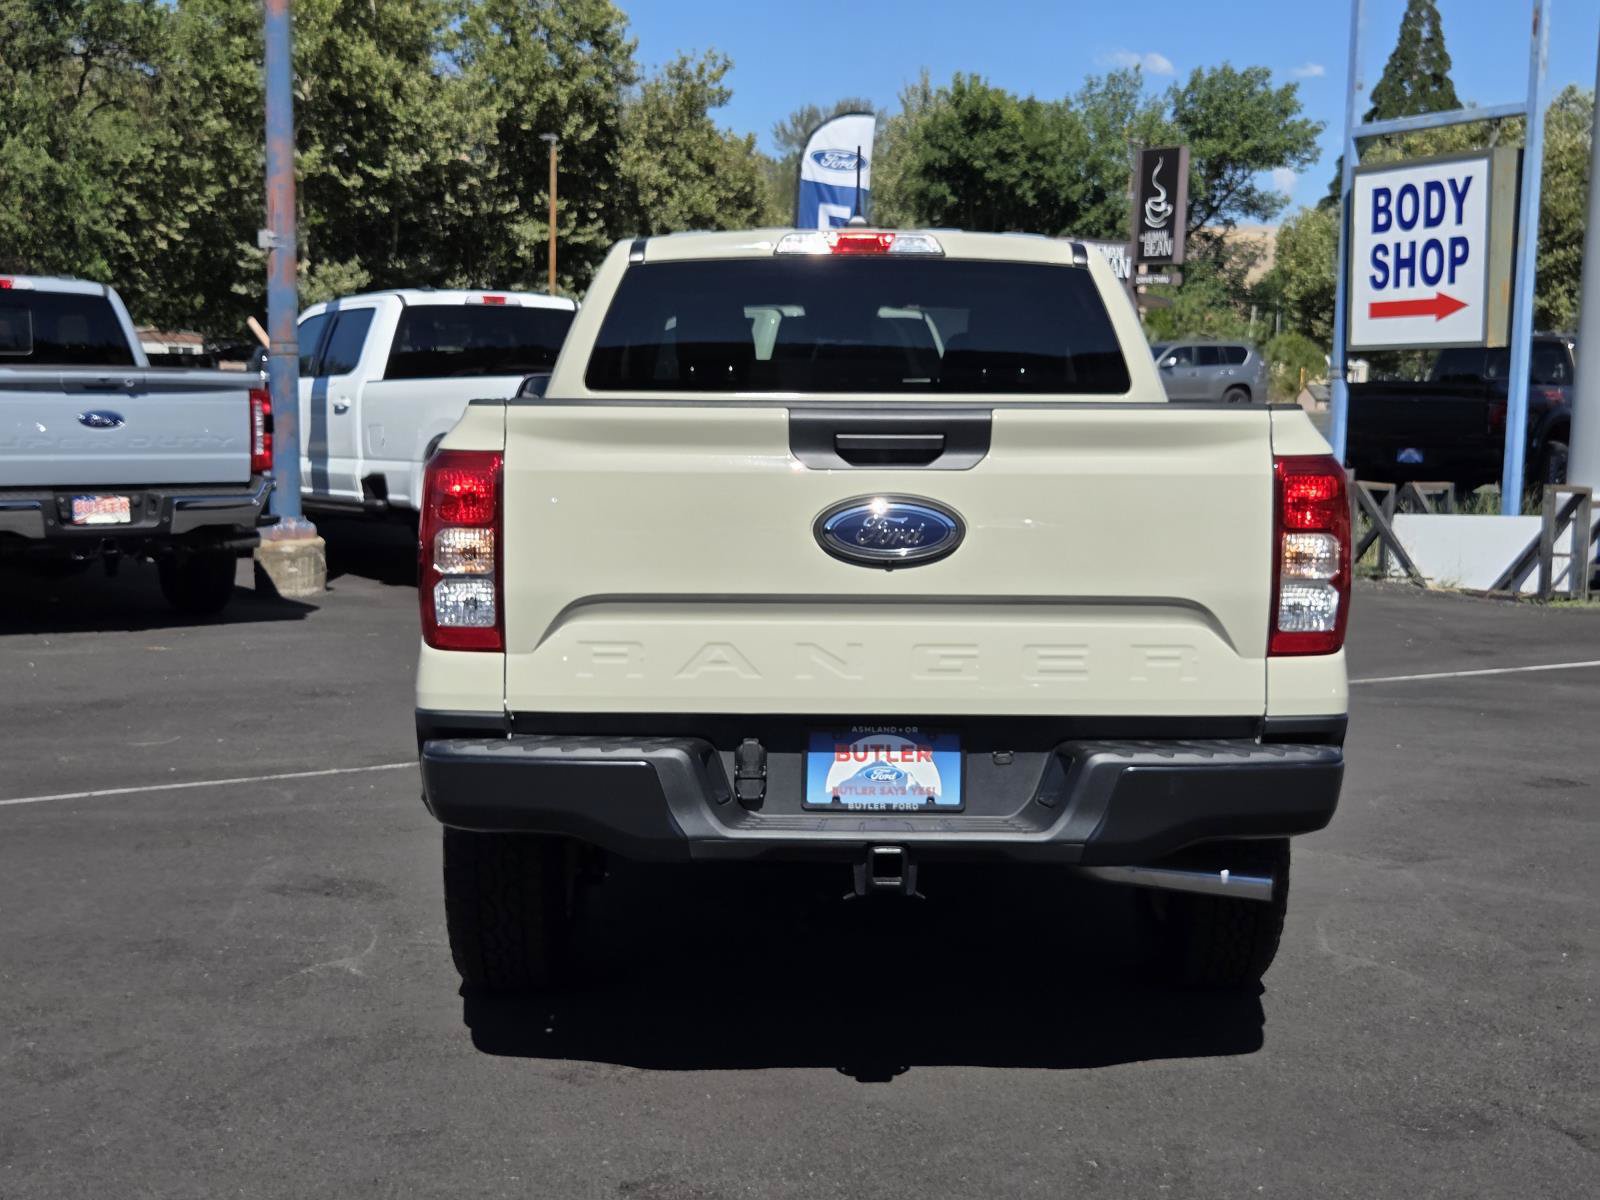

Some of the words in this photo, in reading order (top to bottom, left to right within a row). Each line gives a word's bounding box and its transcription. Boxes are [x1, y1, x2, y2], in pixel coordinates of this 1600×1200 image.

[820, 152, 859, 170] Ford
[1371, 175, 1473, 235] BODY
[1144, 240, 1173, 257] BEAN
[1369, 237, 1470, 291] SHOP
[856, 513, 926, 545] Ford
[575, 640, 1199, 681] RANGER
[835, 744, 933, 763] BUTLER
[870, 768, 897, 780] Ford
[832, 786, 876, 797] BUTLER
[880, 786, 907, 796] SAYS
[911, 786, 936, 797] YES!
[847, 802, 886, 811] BUTLER
[892, 803, 919, 811] FORD
